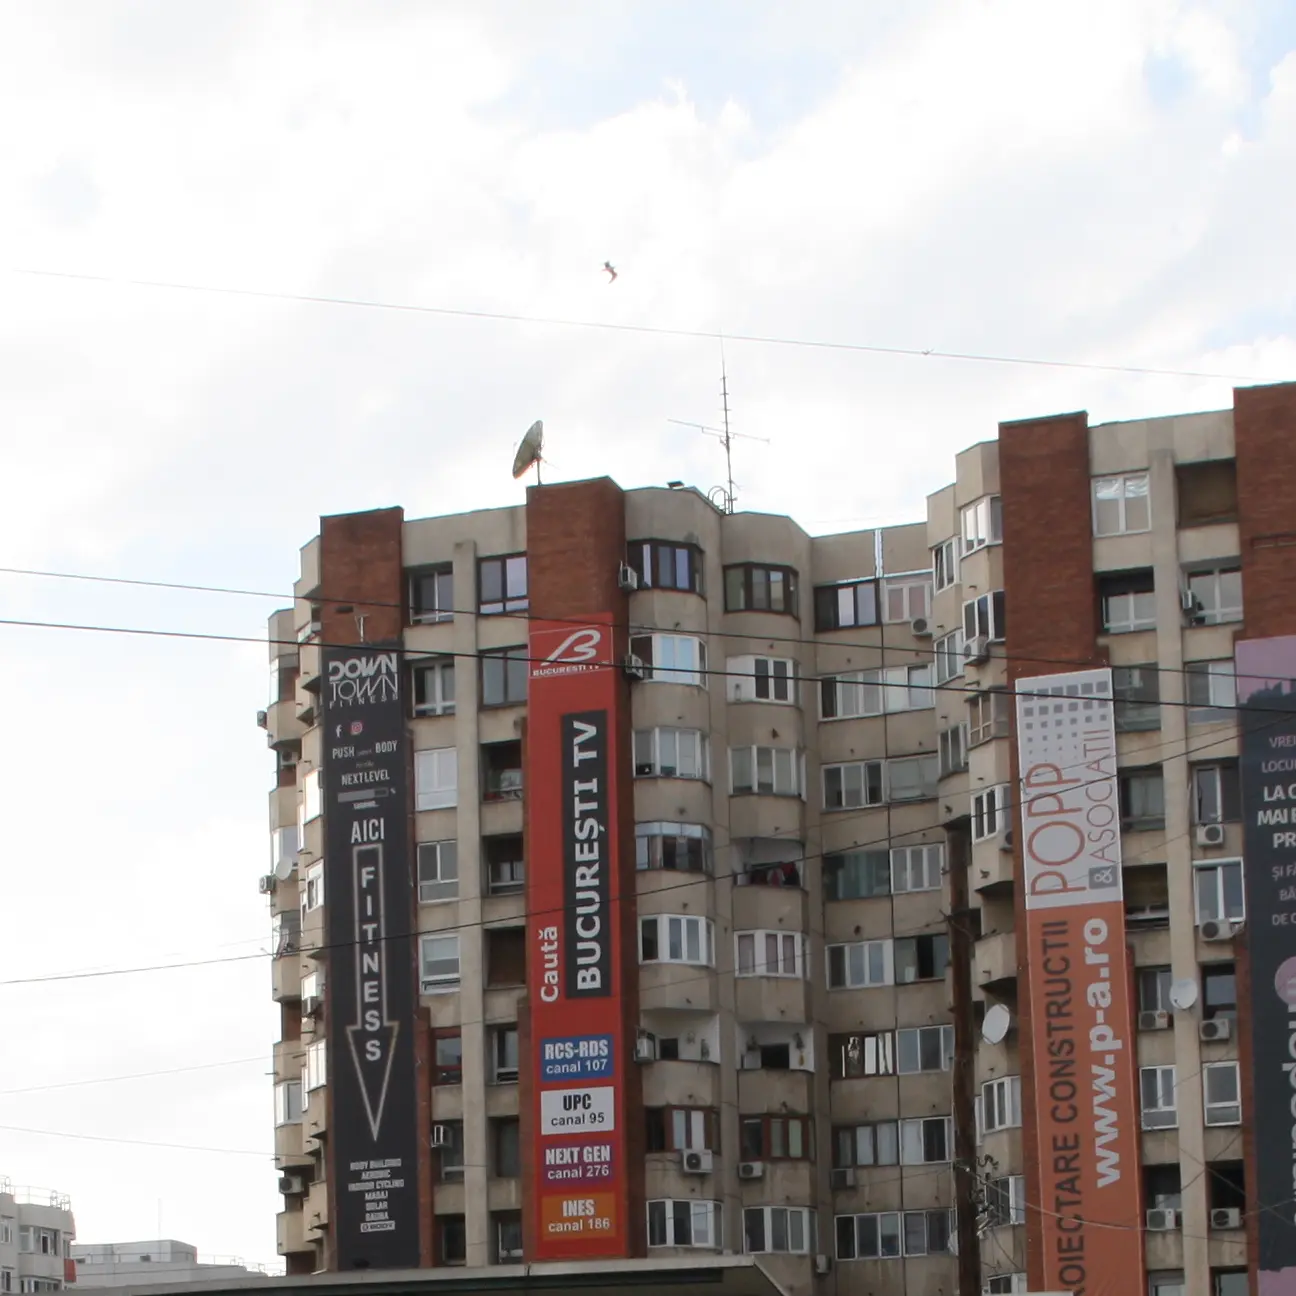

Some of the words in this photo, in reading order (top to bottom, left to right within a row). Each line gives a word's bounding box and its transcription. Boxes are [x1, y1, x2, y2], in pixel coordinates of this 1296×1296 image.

[329, 673, 398, 701] TOWN
[332, 747, 355, 759] PUSH
[375, 740, 398, 753] BODY
[573, 721, 597, 768] TV
[1269, 735, 1296, 748] VREI
[1263, 785, 1286, 802] LA
[1257, 808, 1288, 826] MAI
[351, 818, 384, 843] AICI
[1025, 762, 1087, 896] POPP
[574, 777, 605, 990] BUCUREȘTI
[1272, 913, 1288, 926] DE
[361, 866, 381, 1061] FITNESS
[538, 926, 559, 1003] Caută
[1041, 920, 1078, 1124] CONSTRUCTII
[544, 1039, 609, 1060] RCS-RDS
[1083, 916, 1123, 1188] www.p-a.ro
[546, 1061, 581, 1074] canal
[585, 1059, 608, 1072] 107
[562, 1093, 592, 1112] UPC
[551, 1113, 585, 1126] canal
[589, 1111, 605, 1124] 95
[545, 1146, 580, 1165] NEXT
[583, 1144, 611, 1164] GEN
[547, 1166, 582, 1180] canal
[586, 1164, 609, 1178] 276
[562, 1199, 594, 1217] INES
[548, 1220, 583, 1233] canal
[588, 1217, 610, 1230] 186
